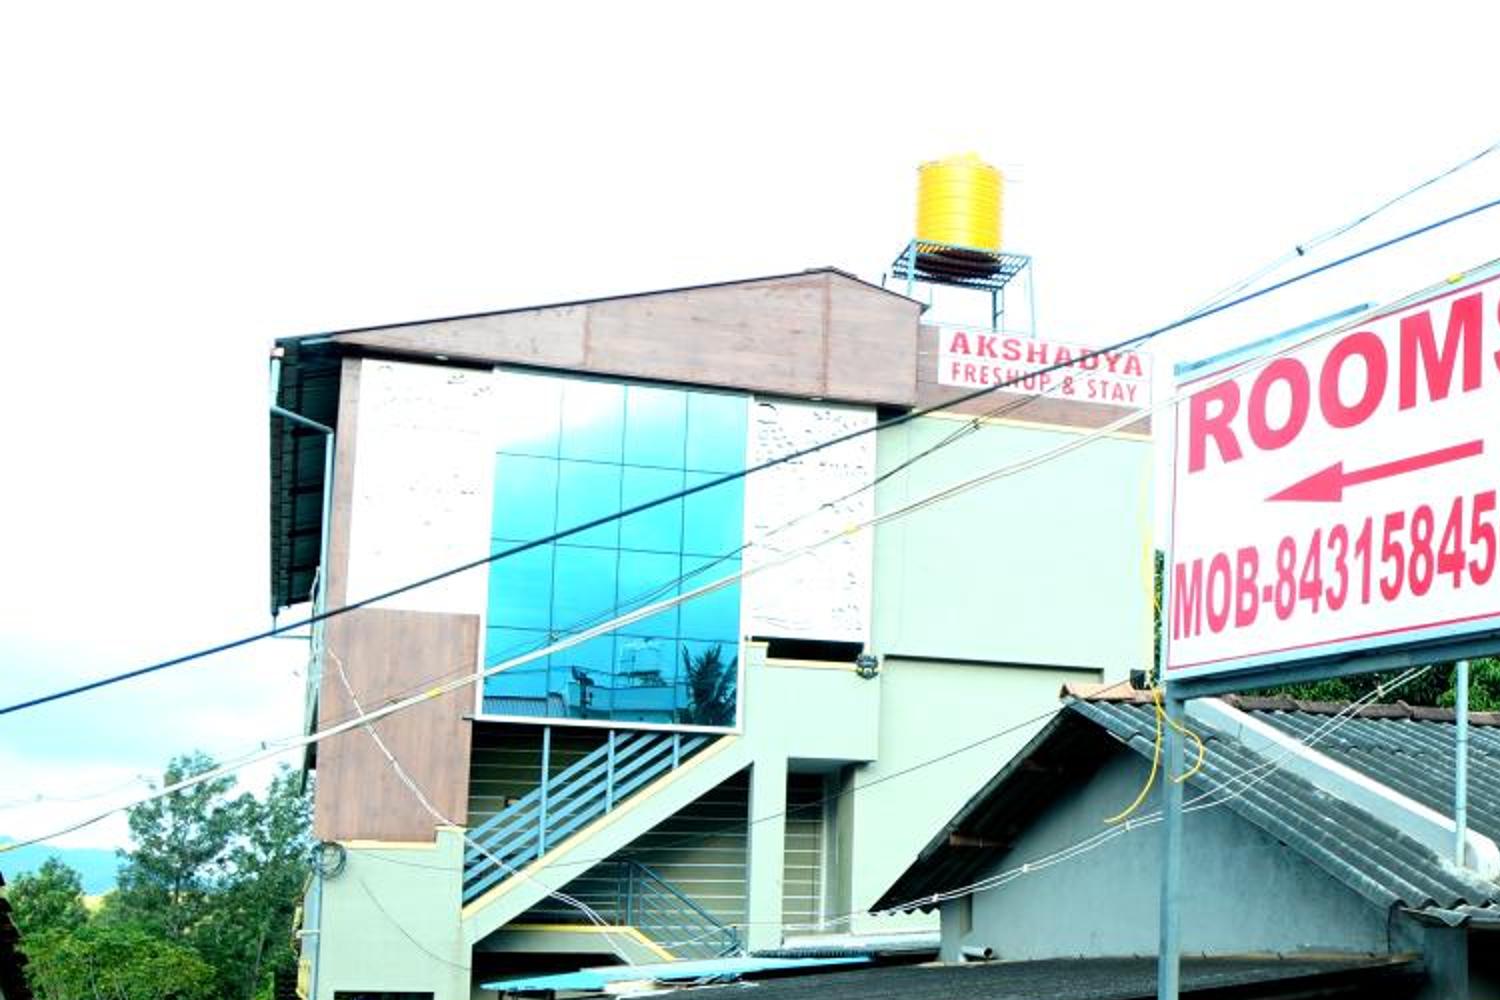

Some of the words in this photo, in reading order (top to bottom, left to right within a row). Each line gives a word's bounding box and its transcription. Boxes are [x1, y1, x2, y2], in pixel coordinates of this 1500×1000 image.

[949, 330, 1144, 377] AKSHADYA
[1061, 375, 1075, 395] &
[1087, 378, 1138, 403] STAY
